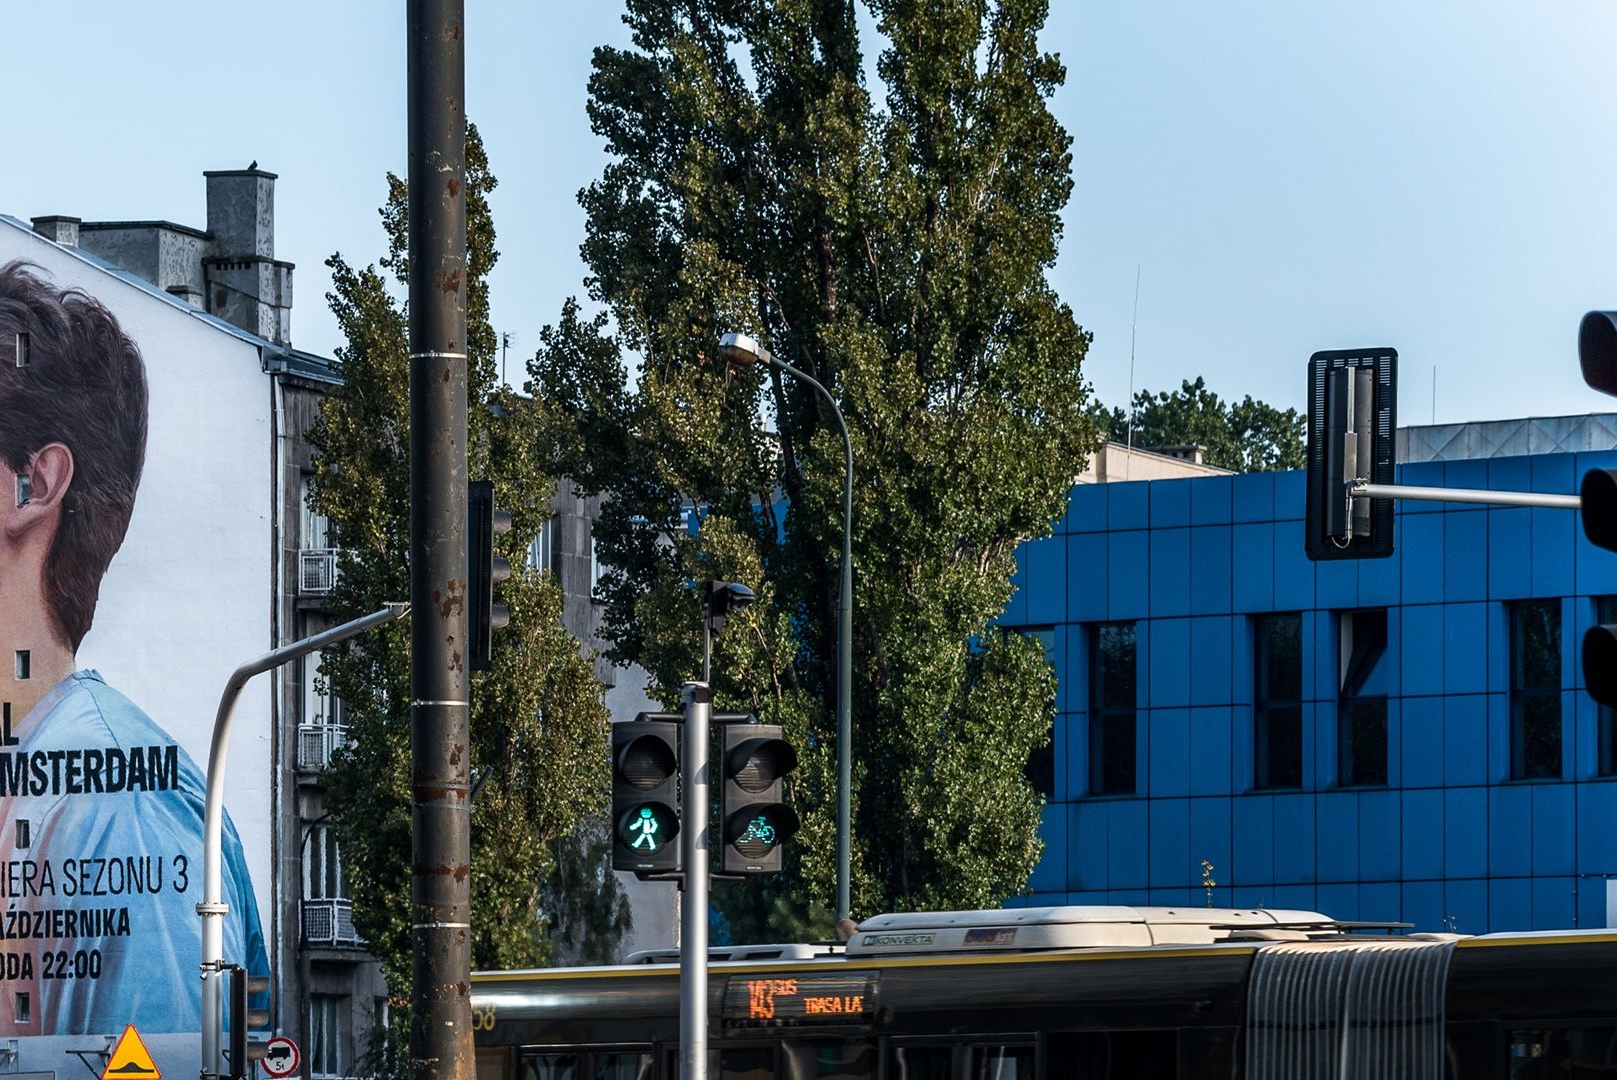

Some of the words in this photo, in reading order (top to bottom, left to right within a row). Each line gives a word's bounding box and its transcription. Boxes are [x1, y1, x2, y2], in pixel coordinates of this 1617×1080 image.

[62, 855, 163, 898] SEZONU
[172, 854, 189, 894] 3
[42, 949, 102, 980] 22:00
